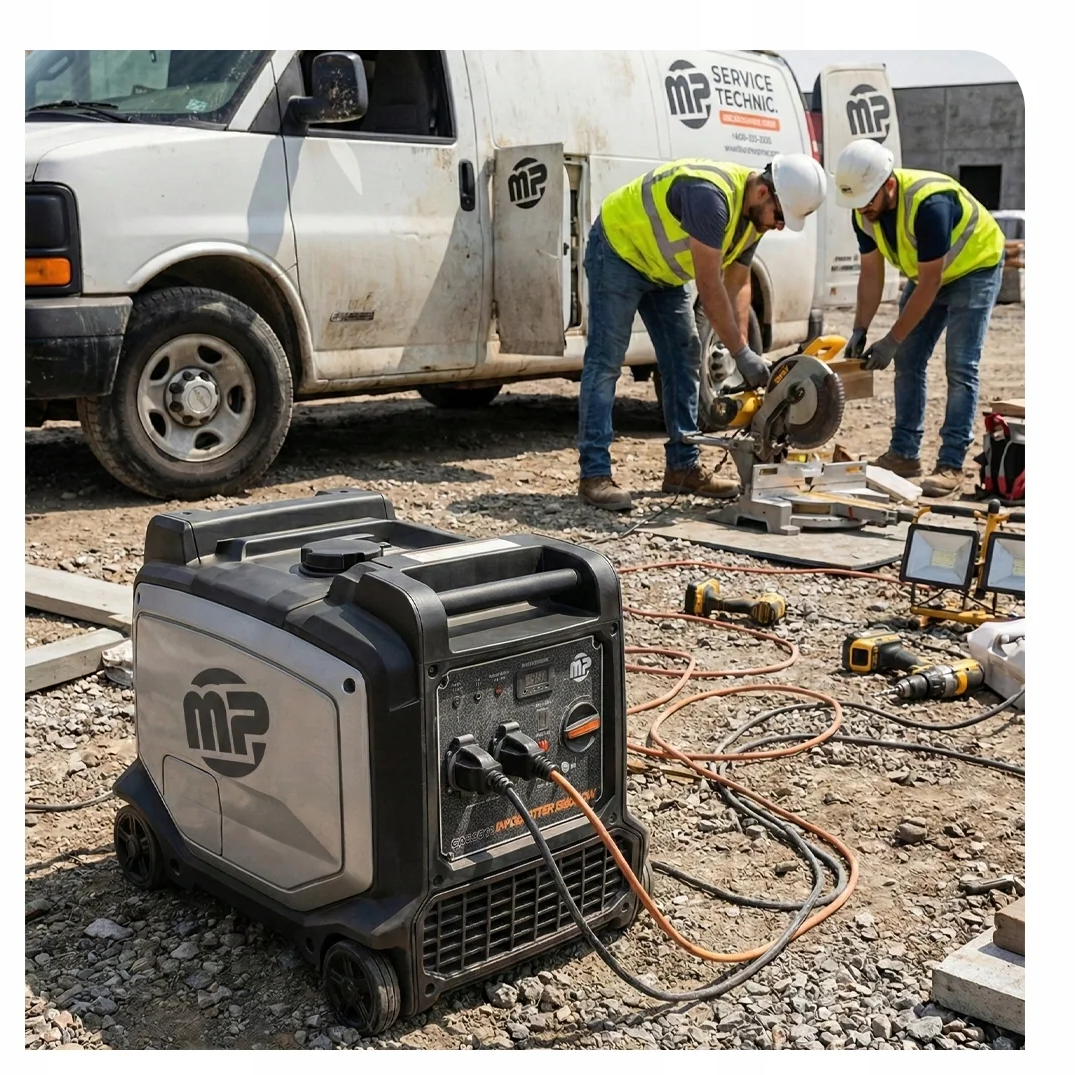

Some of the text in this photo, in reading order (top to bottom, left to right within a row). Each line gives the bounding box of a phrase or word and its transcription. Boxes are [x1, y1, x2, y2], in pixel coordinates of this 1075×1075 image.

[665, 64, 711, 125] MP
[711, 65, 774, 92] SERVICE
[715, 87, 779, 113] TECHNIC.
[846, 88, 890, 141] MP
[508, 159, 547, 207] MP
[570, 653, 592, 681] MP
[183, 676, 270, 769] MP
